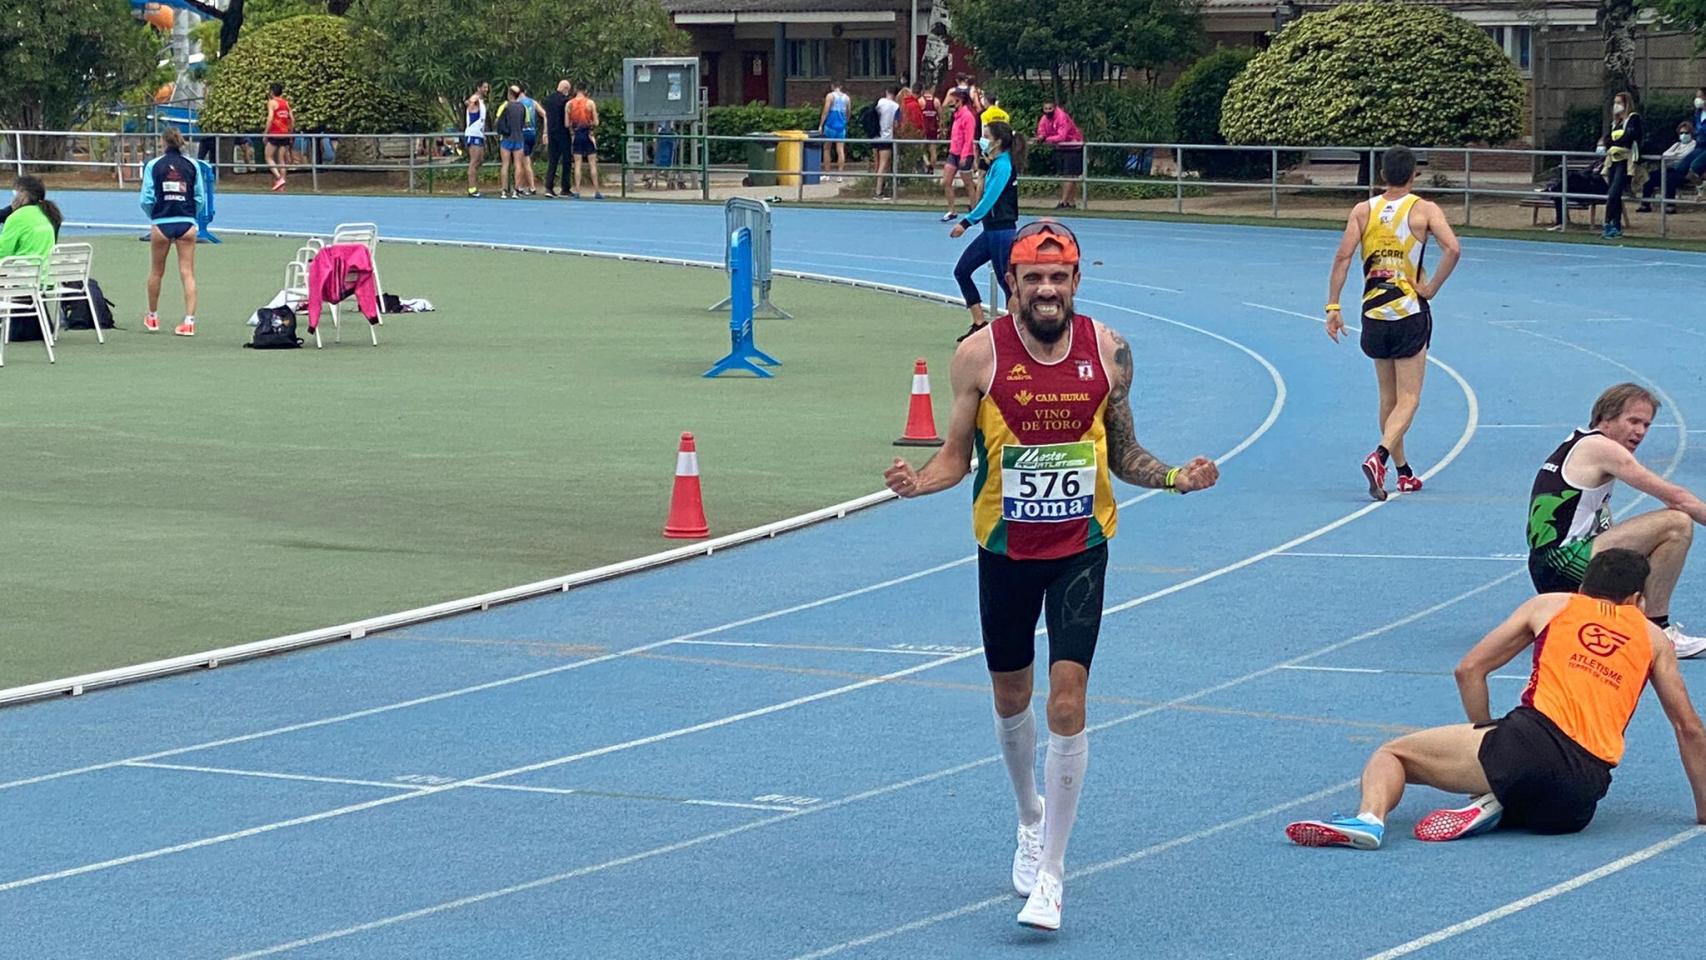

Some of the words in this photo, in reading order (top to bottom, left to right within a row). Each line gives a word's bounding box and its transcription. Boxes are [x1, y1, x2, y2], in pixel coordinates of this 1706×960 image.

[1035, 394, 1058, 402] CAJA
[1060, 393, 1090, 402] RURAL
[1034, 409, 1071, 420] VINO
[1022, 422, 1040, 431] DE
[1044, 420, 1082, 431] TORO
[1019, 471, 1081, 498] 576
[1570, 653, 1623, 683] ATLETISME
